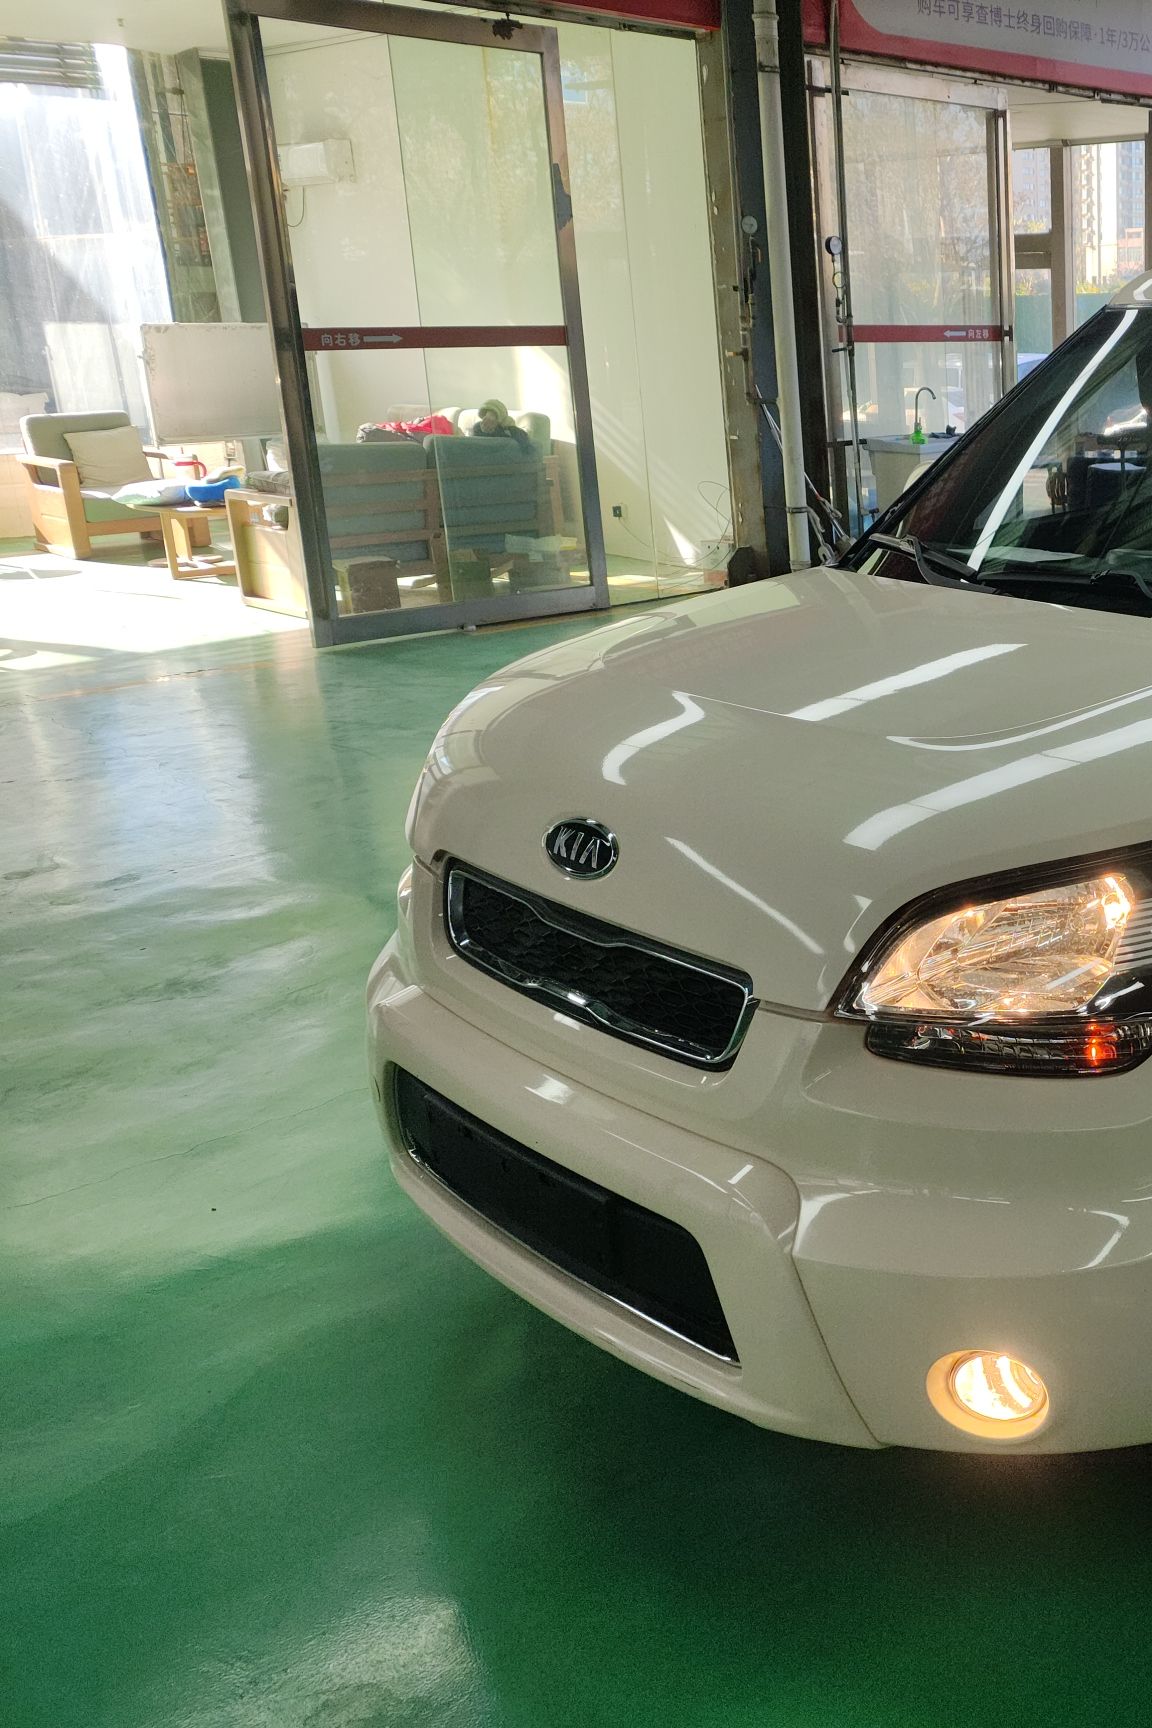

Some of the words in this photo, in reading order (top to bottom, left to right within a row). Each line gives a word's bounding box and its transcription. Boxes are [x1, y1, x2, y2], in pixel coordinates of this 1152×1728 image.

[320, 332, 361, 347] 向右移
[967, 328, 990, 340] 向左移
[553, 826, 601, 870] KIA
